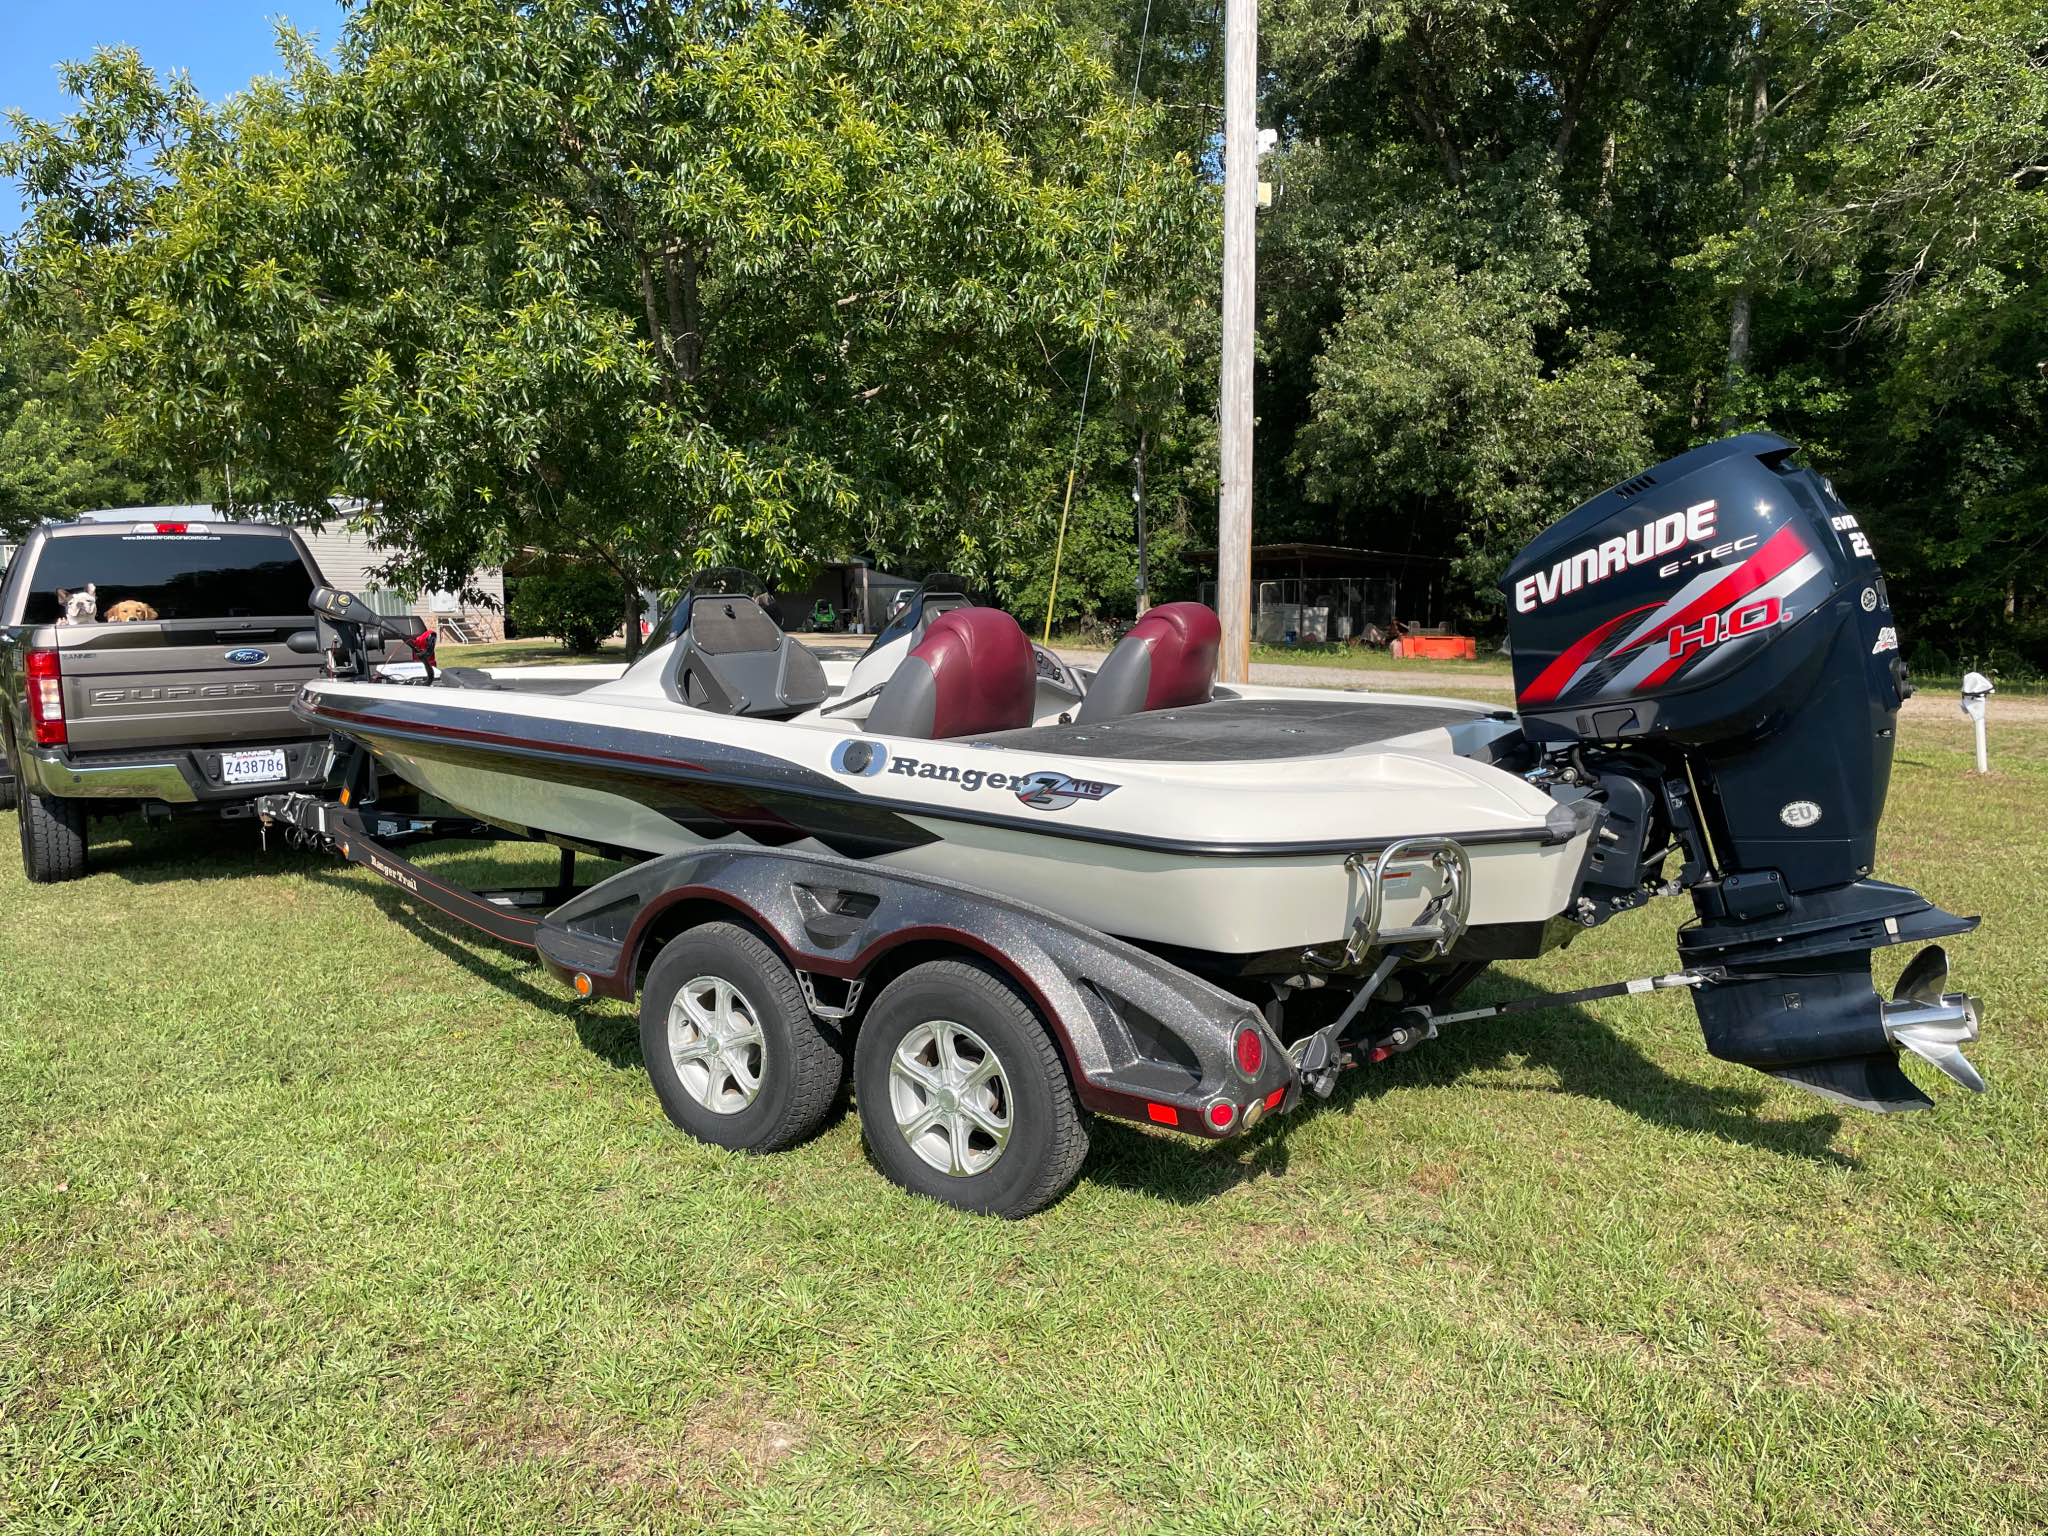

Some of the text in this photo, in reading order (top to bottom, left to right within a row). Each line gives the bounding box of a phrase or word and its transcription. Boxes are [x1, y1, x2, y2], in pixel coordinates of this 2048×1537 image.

[1831, 514, 1859, 531] EVIN
[1515, 500, 1718, 614] EVINRUDE
[1659, 535, 1758, 578] E-TEC
[1848, 532, 1876, 560] 22
[1668, 596, 1793, 659] H.O.
[95, 683, 262, 703] SUPER
[226, 760, 284, 775] Z438786
[887, 756, 1031, 792] Ranger
[1071, 780, 1104, 795] 119
[1785, 806, 1812, 822] EU
